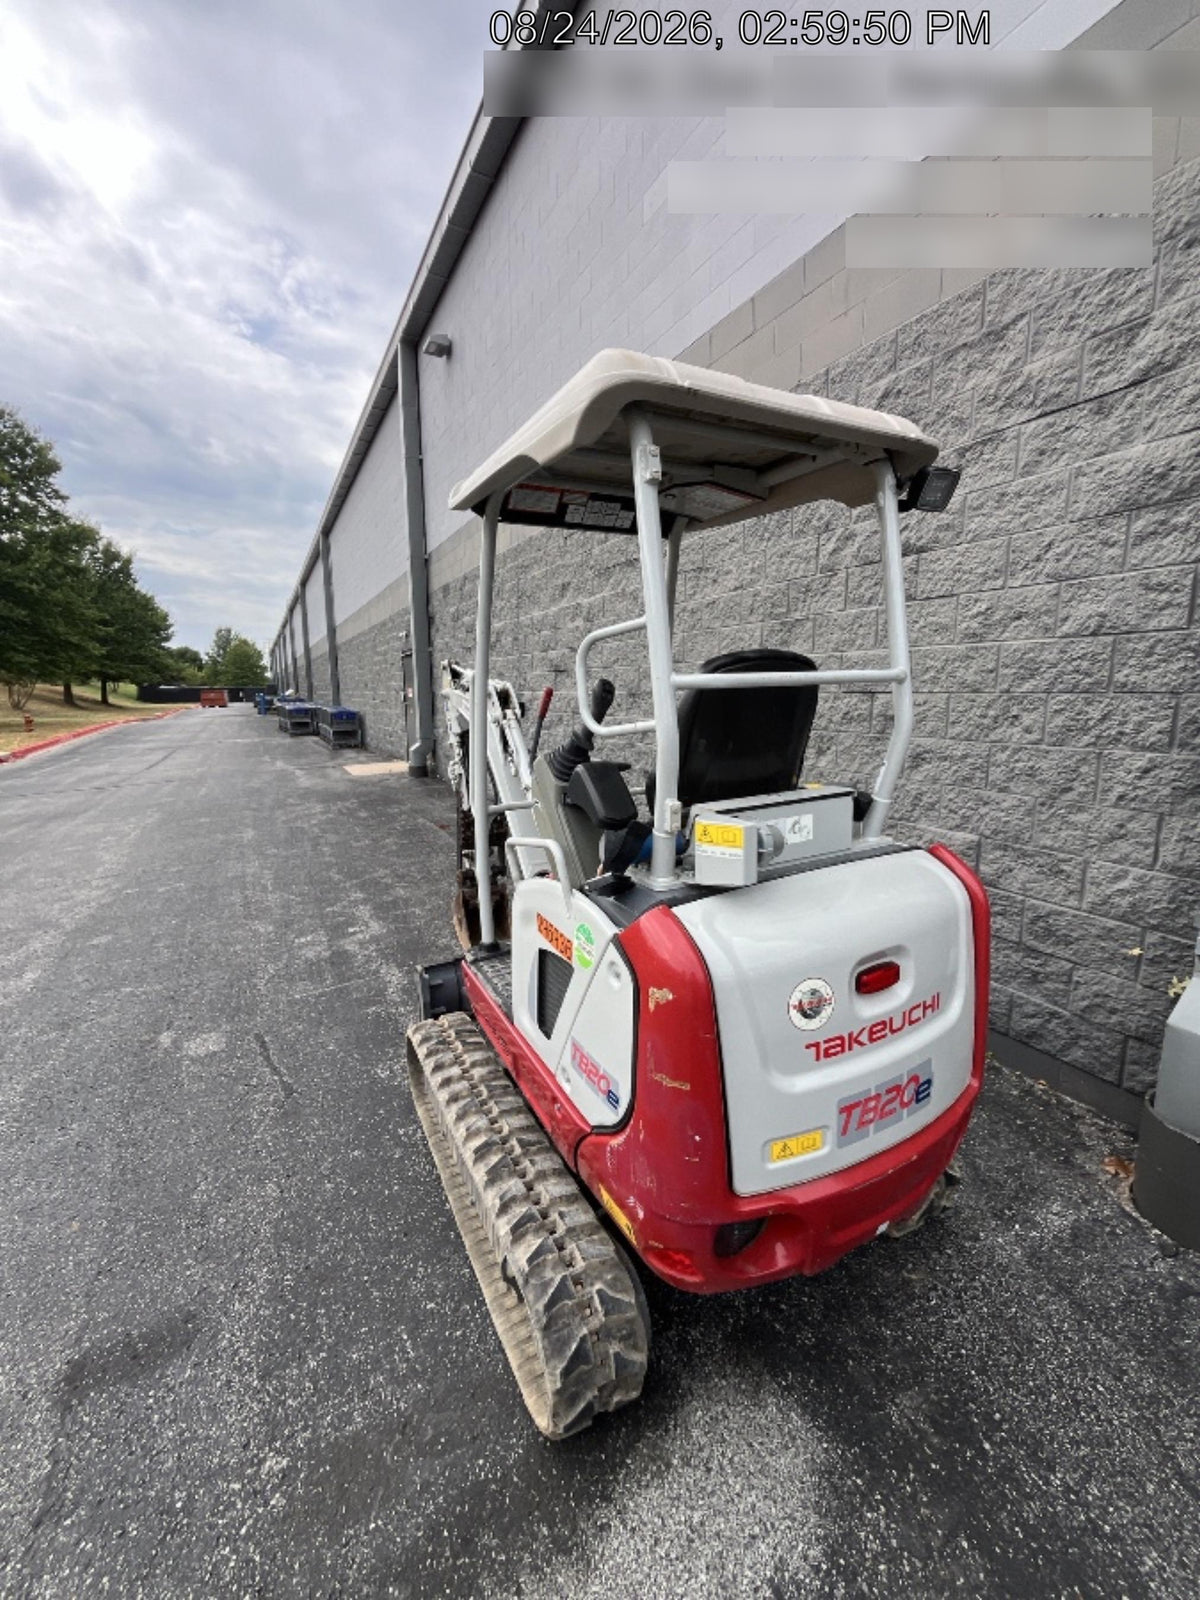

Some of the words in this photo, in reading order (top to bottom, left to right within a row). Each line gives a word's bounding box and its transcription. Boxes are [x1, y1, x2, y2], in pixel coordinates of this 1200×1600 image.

[805, 992, 940, 1062] TAKEUCHI
[571, 1041, 619, 1110] TB20e
[838, 1073, 932, 1137] TB20e
